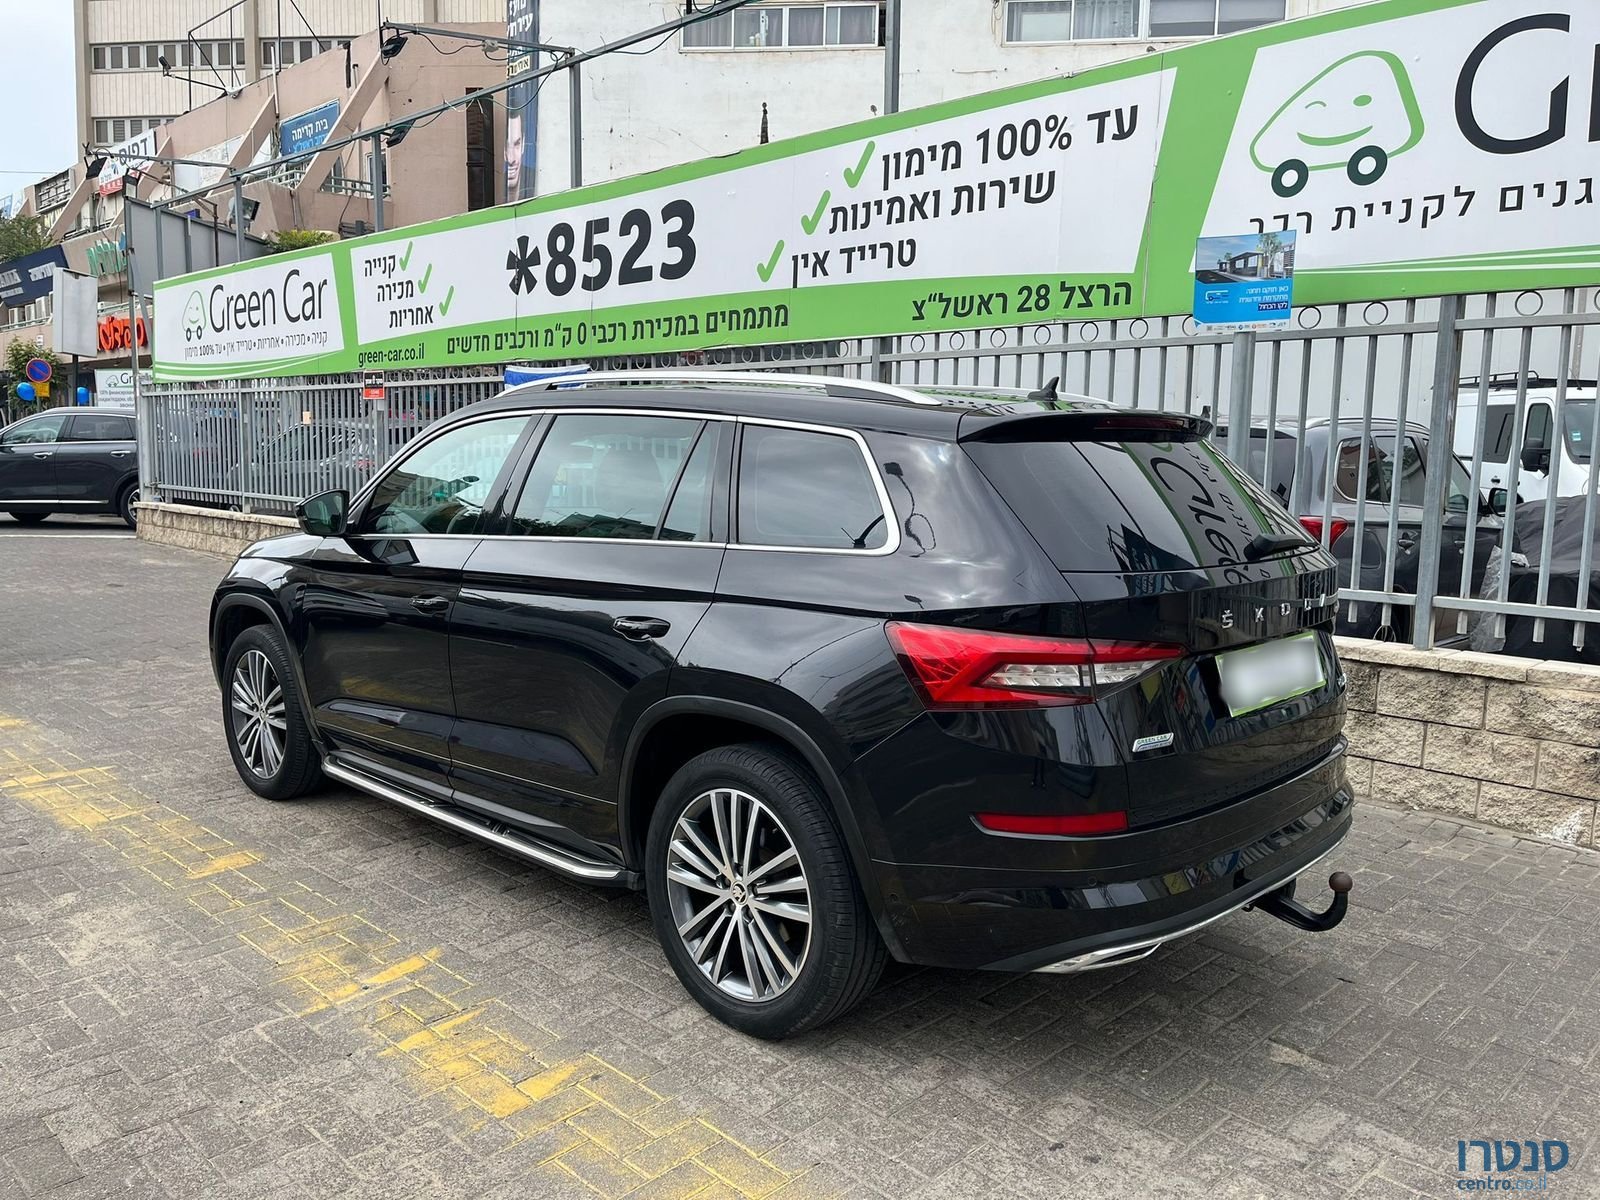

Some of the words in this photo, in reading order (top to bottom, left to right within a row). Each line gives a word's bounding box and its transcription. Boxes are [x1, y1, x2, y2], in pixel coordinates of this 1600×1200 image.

[292, 123, 313, 141] קדימה
[316, 119, 328, 133] בית
[1087, 105, 1138, 143] עד
[119, 138, 147, 165] דפוס
[976, 114, 1072, 163] 100%
[882, 141, 962, 191] מימון
[951, 171, 1056, 215] שירות
[829, 190, 941, 234] ואמינות
[1332, 186, 1475, 230] לקניית
[364, 255, 395, 278] קנייה
[840, 239, 917, 273] טרייד
[792, 251, 830, 289] אין
[209, 284, 276, 333] Green
[283, 269, 327, 322] Car
[377, 280, 413, 302] מכירה
[1017, 283, 1050, 312] 28
[1060, 281, 1132, 309] הרצל
[389, 305, 433, 329] אחריות
[705, 304, 789, 333] מתמחים
[912, 292, 1008, 320] ראשל"צ
[495, 330, 539, 351] ורכבים
[544, 323, 572, 348] ק"מ
[577, 322, 587, 345] 0
[592, 322, 627, 343] רכבי
[632, 314, 699, 340] במכירת
[358, 342, 425, 367] green-car.co.il
[447, 335, 490, 354] חדשים
